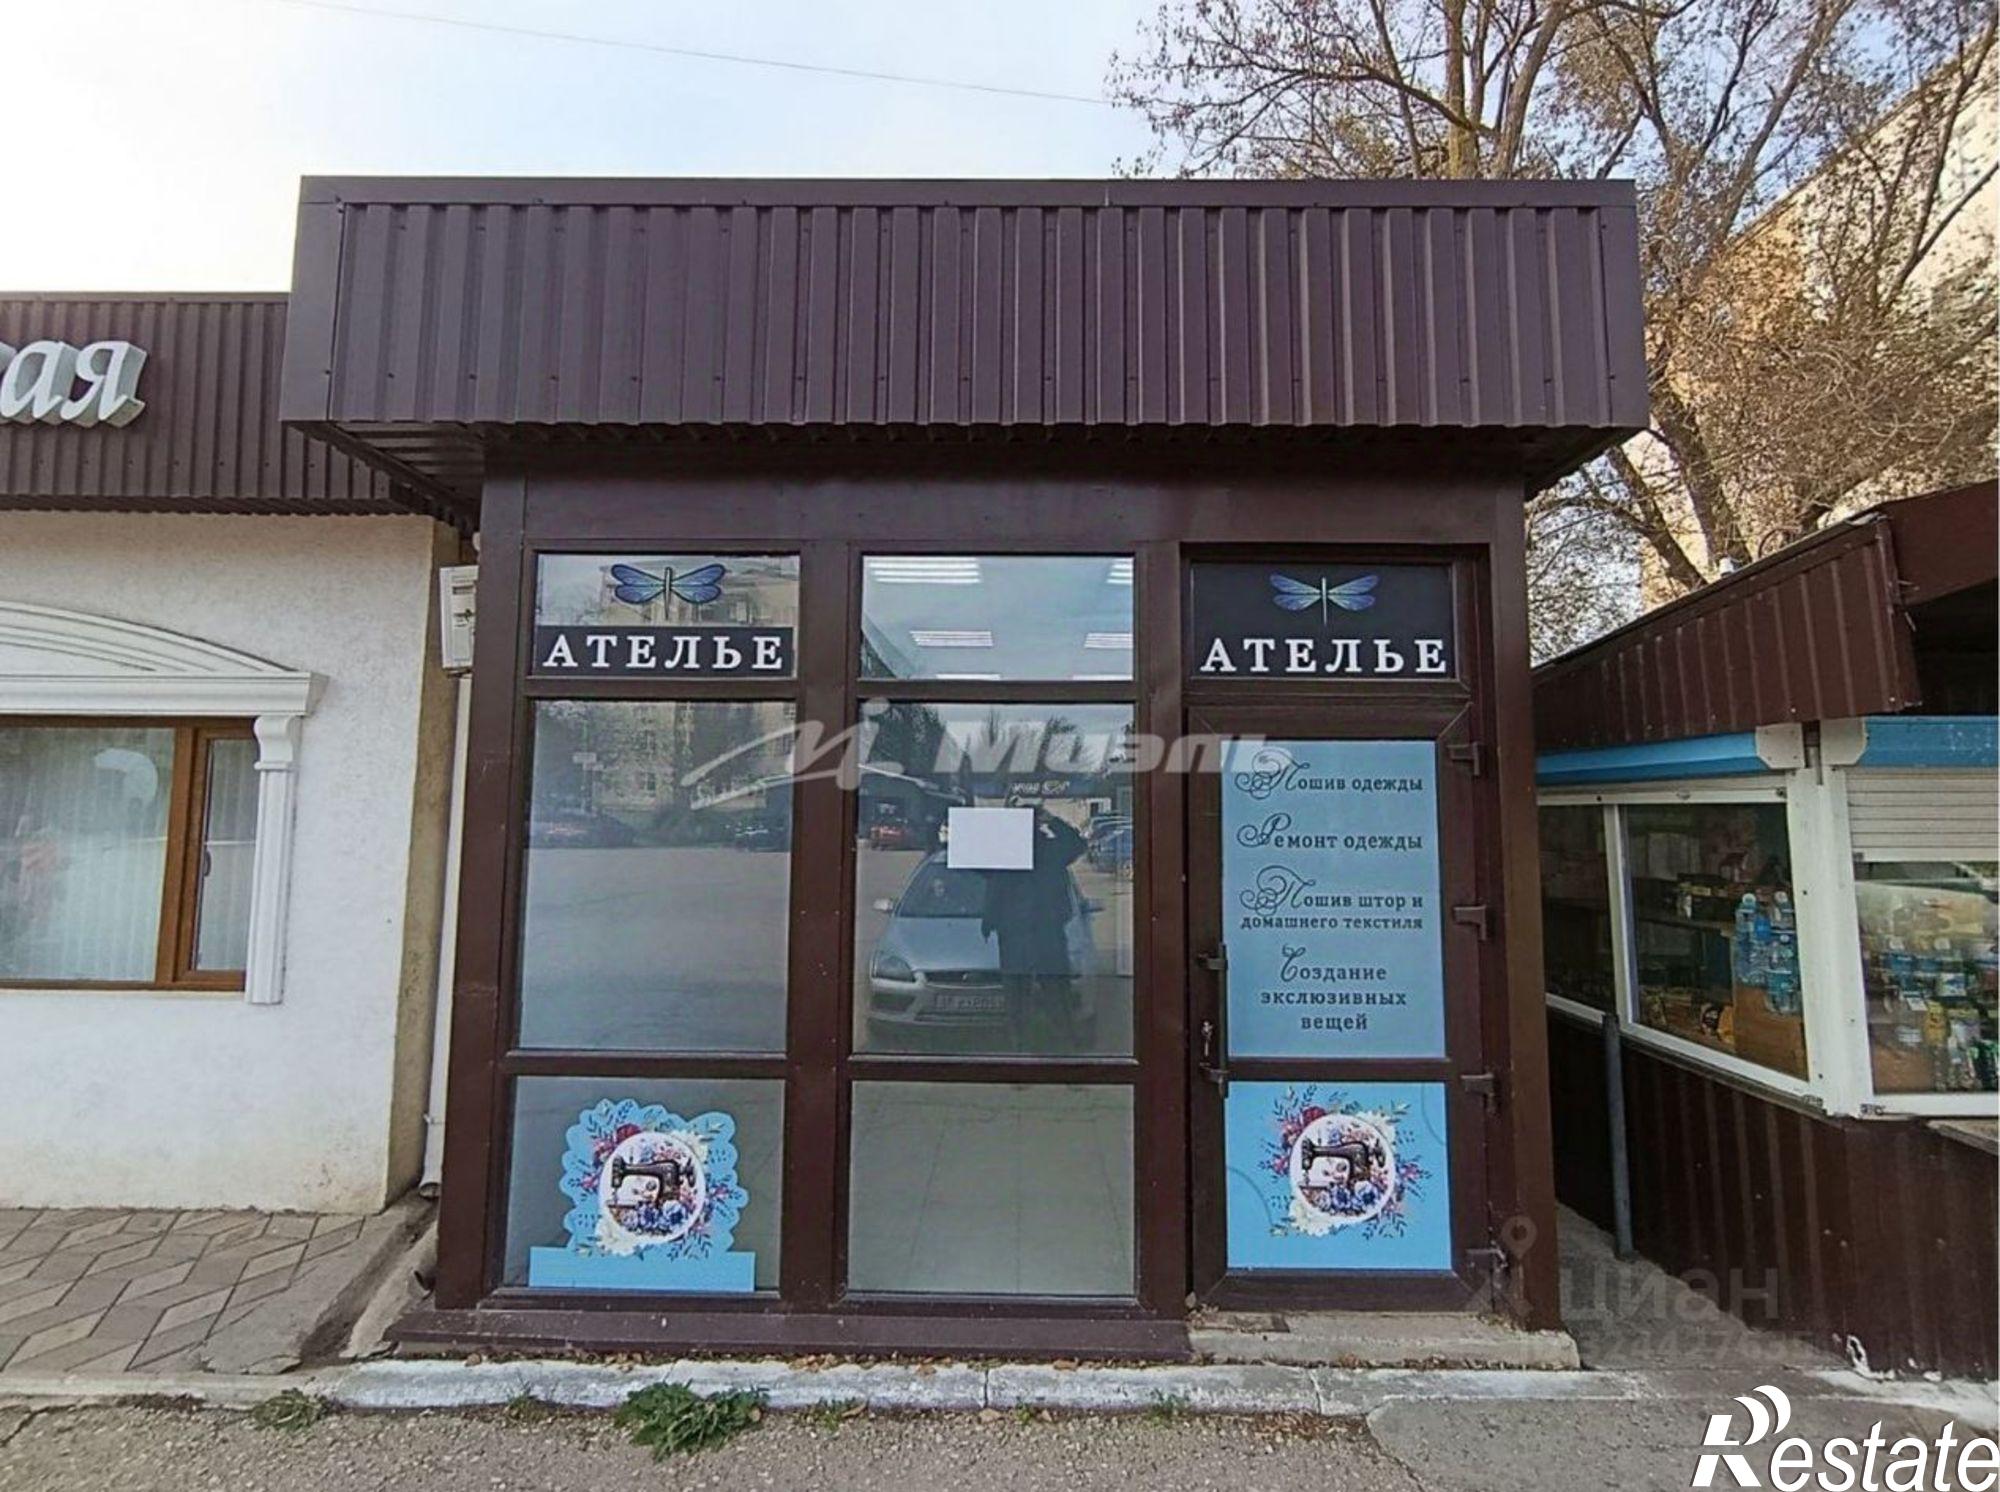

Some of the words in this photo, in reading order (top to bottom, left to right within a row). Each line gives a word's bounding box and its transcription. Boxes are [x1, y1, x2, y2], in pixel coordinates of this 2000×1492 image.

[0, 340, 146, 427] ая
[542, 634, 783, 669] АТЕЛЬЕ
[1200, 638, 1446, 673] АТЕЛЬЕ
[1234, 748, 1346, 800] Пошив
[1352, 777, 1423, 793] одежды
[1236, 812, 1337, 848] Ремонт
[1344, 834, 1423, 851] одежды
[1239, 865, 1352, 917] Пошив
[1358, 894, 1406, 911] штор
[1412, 894, 1423, 907] и
[1240, 915, 1339, 930] домашнего
[1342, 915, 1423, 929] текстиля
[1280, 943, 1388, 983] Создание
[1260, 990, 1407, 1006] экслюзивных
[1301, 1013, 1368, 1032] вещей
